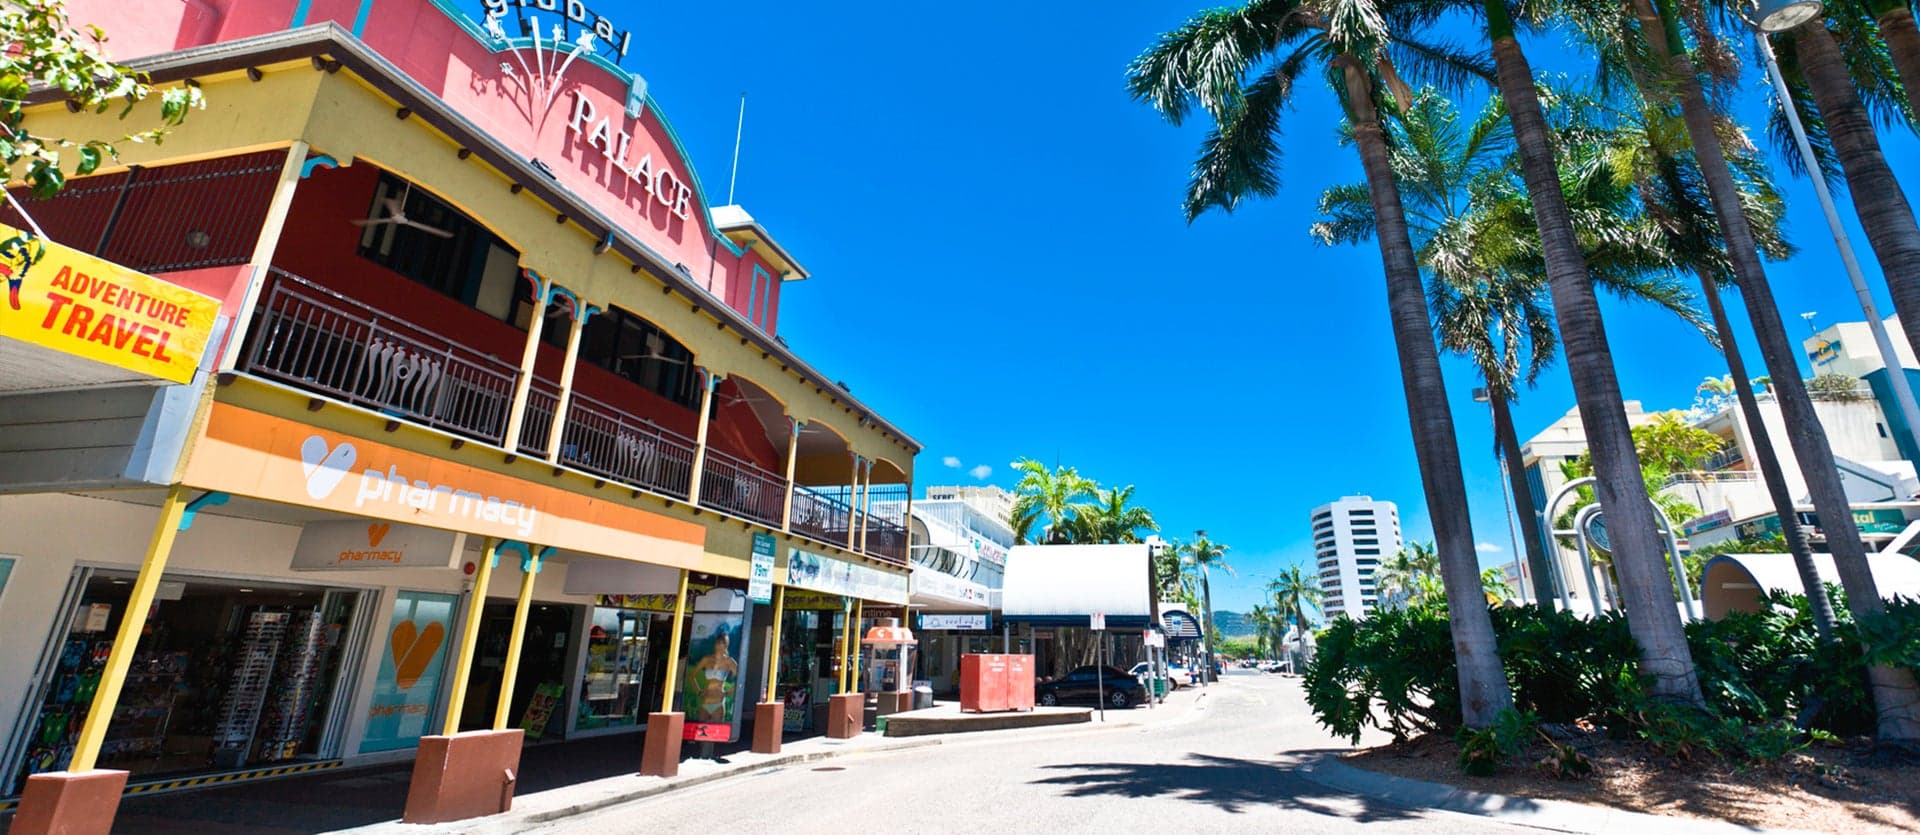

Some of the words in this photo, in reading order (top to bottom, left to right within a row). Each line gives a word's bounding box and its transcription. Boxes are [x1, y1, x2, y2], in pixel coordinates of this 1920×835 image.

[484, 0, 631, 56] gobal
[567, 89, 692, 221] PALACE
[41, 292, 172, 363] TRAVEL
[50, 265, 191, 328] ADVENTURE
[355, 464, 537, 537] pharmacy
[338, 549, 403, 564] pharmacy
